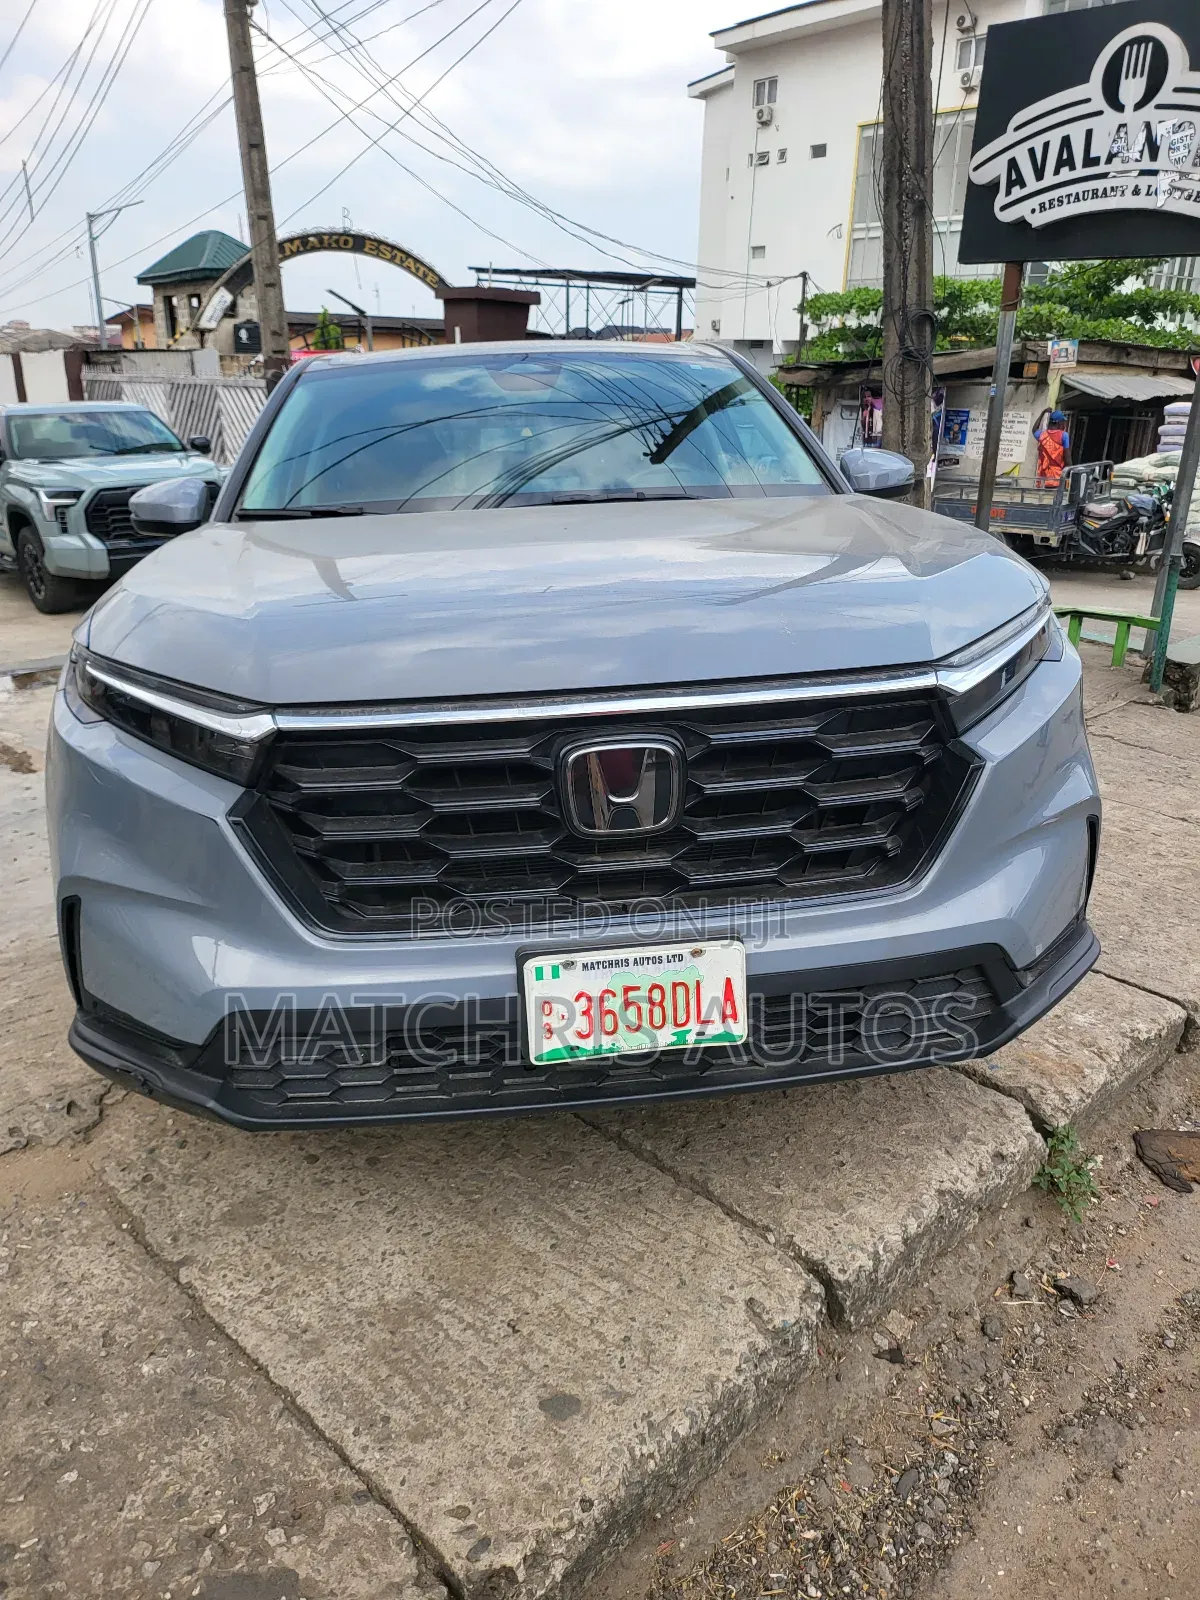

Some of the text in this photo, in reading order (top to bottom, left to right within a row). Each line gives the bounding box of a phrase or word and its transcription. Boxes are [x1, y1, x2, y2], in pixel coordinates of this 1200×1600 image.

[1038, 185, 1128, 213] RESTAURANT
[1131, 184, 1142, 196] &
[363, 239, 440, 288] ESTATE
[581, 953, 684, 972] MATCHRIS AUTOS LTD
[573, 976, 739, 1040] 3658DLA
